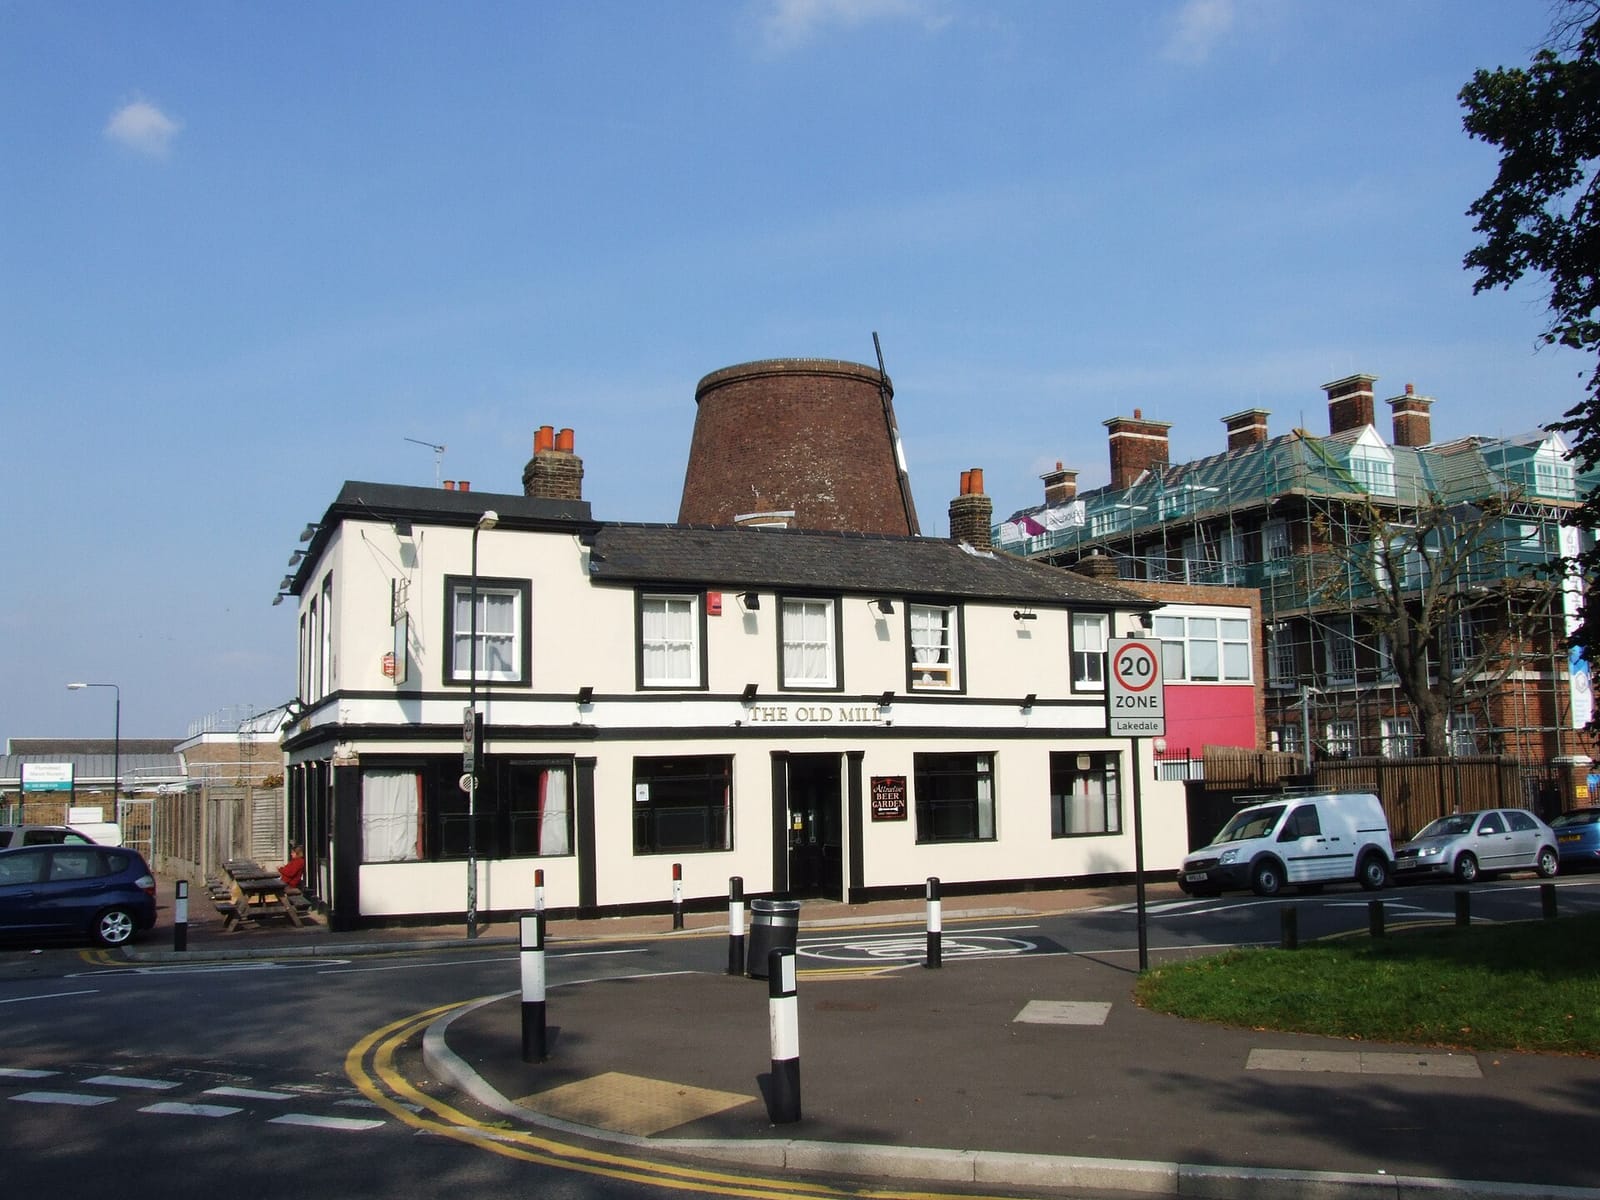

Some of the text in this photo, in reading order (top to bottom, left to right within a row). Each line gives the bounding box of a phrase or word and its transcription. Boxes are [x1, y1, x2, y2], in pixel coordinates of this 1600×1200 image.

[1120, 657, 1150, 676] 20
[1115, 695, 1158, 708] ZONE
[750, 706, 883, 722] THE OLD MILL
[1116, 721, 1158, 730] Lakedale
[876, 792, 900, 800] BEER
[872, 800, 905, 808] GARDEN
